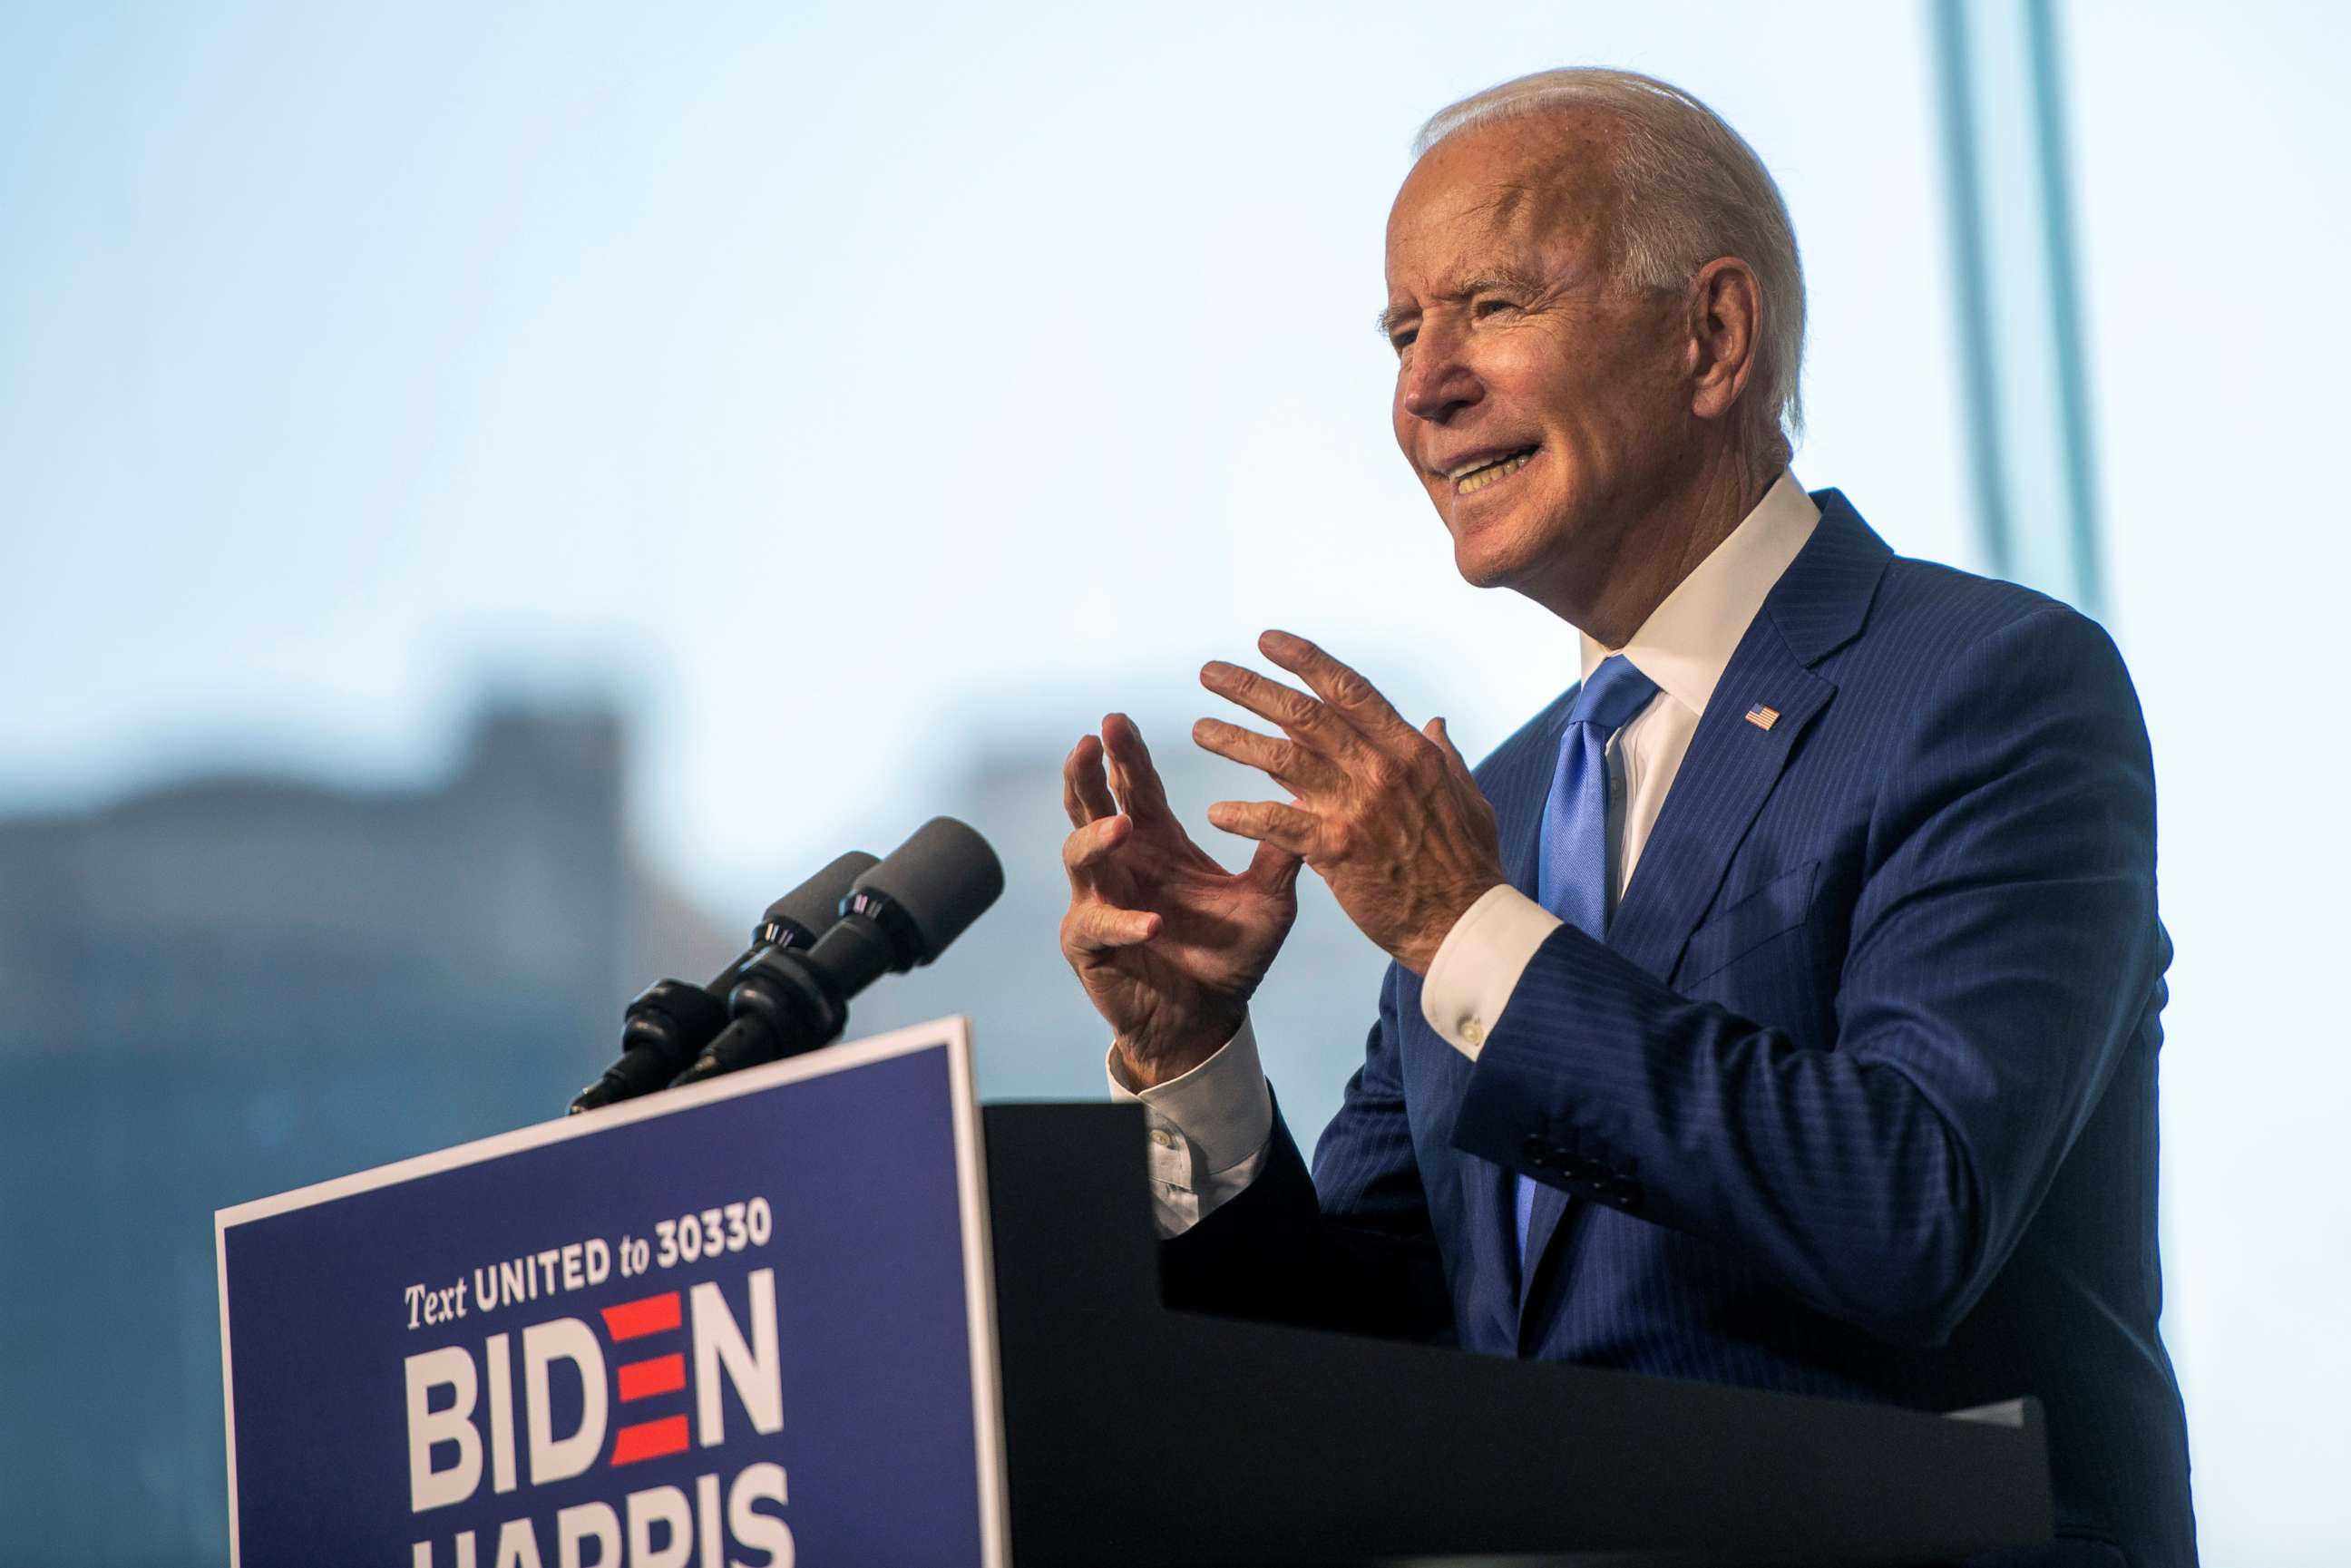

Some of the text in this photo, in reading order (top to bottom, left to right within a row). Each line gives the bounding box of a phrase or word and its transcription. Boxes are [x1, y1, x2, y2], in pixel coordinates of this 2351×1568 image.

[404, 1196, 772, 1330] Text UNITED to 30330
[404, 1268, 784, 1514] BIDEN
[412, 1461, 795, 1568] RIS
